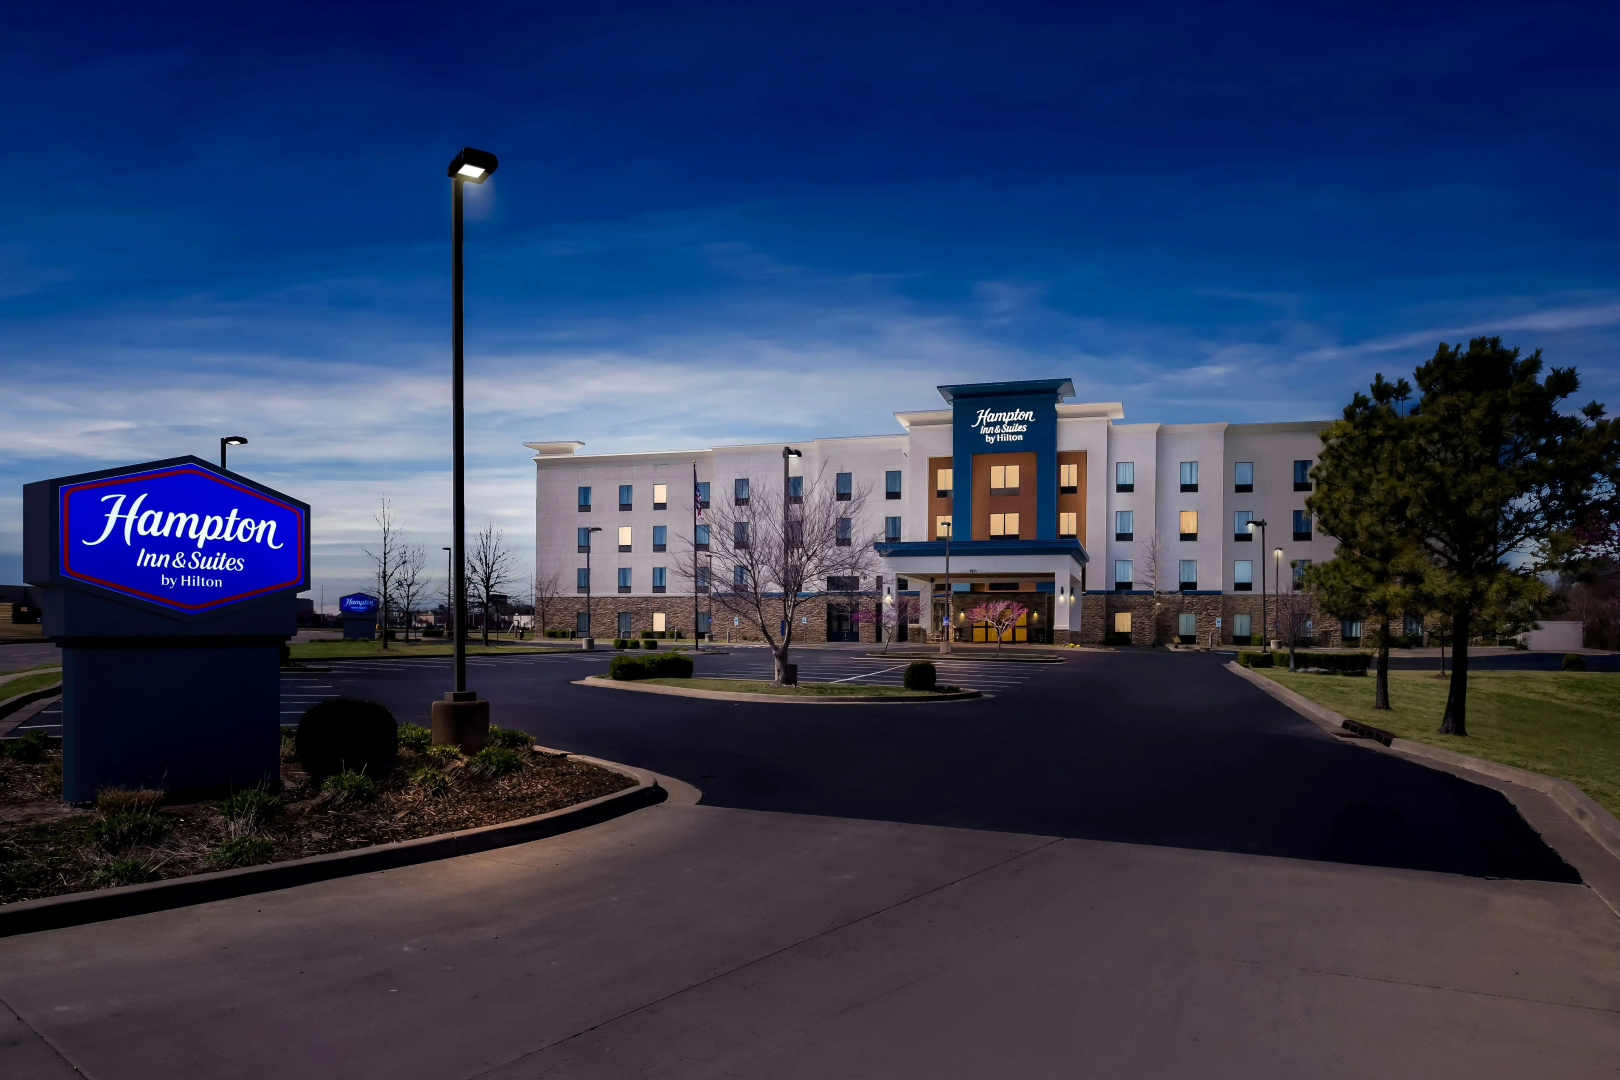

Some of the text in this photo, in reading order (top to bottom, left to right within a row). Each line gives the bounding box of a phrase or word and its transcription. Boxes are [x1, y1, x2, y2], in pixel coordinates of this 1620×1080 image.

[971, 407, 1036, 427] Hampton
[985, 433, 1024, 444] by Hilton
[82, 493, 284, 550] Hampton
[161, 574, 223, 589] by Hilton
